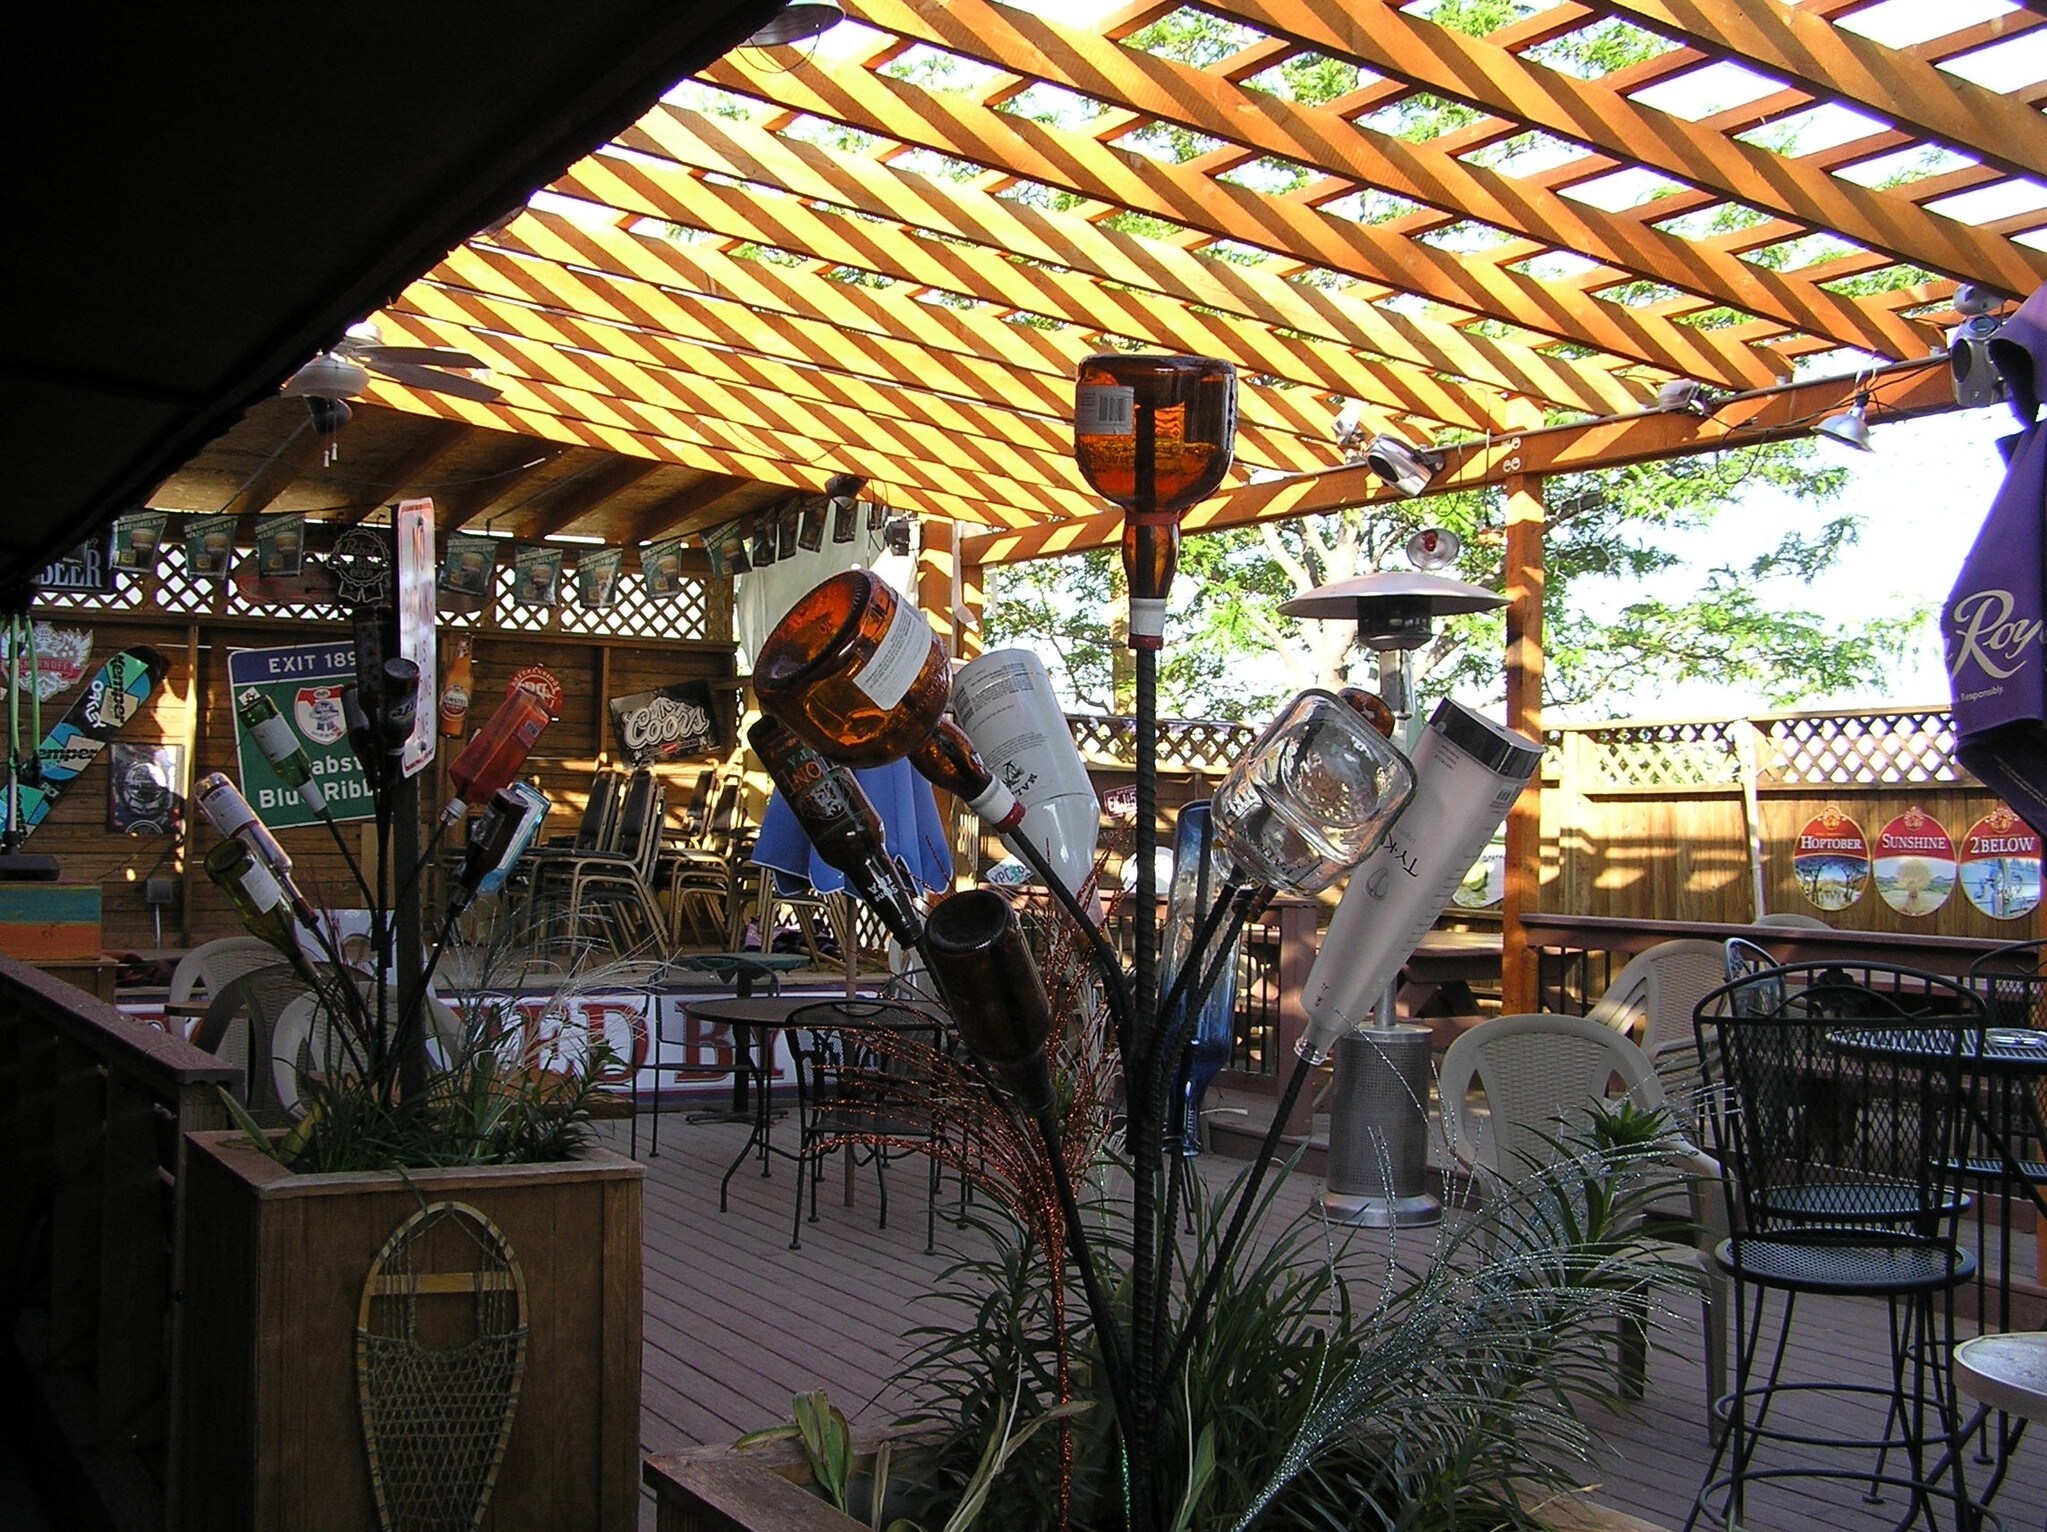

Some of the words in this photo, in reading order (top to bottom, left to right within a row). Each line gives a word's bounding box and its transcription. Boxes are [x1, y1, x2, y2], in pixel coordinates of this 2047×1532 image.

[20, 660, 69, 671] SMRNOFF
[268, 655, 316, 674] EXIT
[109, 655, 127, 724] Kemper
[622, 706, 710, 750] Coors
[38, 747, 101, 763] emper
[312, 756, 364, 775] abst
[1011, 773, 1038, 796] MAL
[259, 788, 305, 808] Blu
[1801, 835, 1863, 850] HOPTOBER
[1882, 833, 1947, 850] SUNSHINE
[1981, 836, 2036, 853] BELOW
